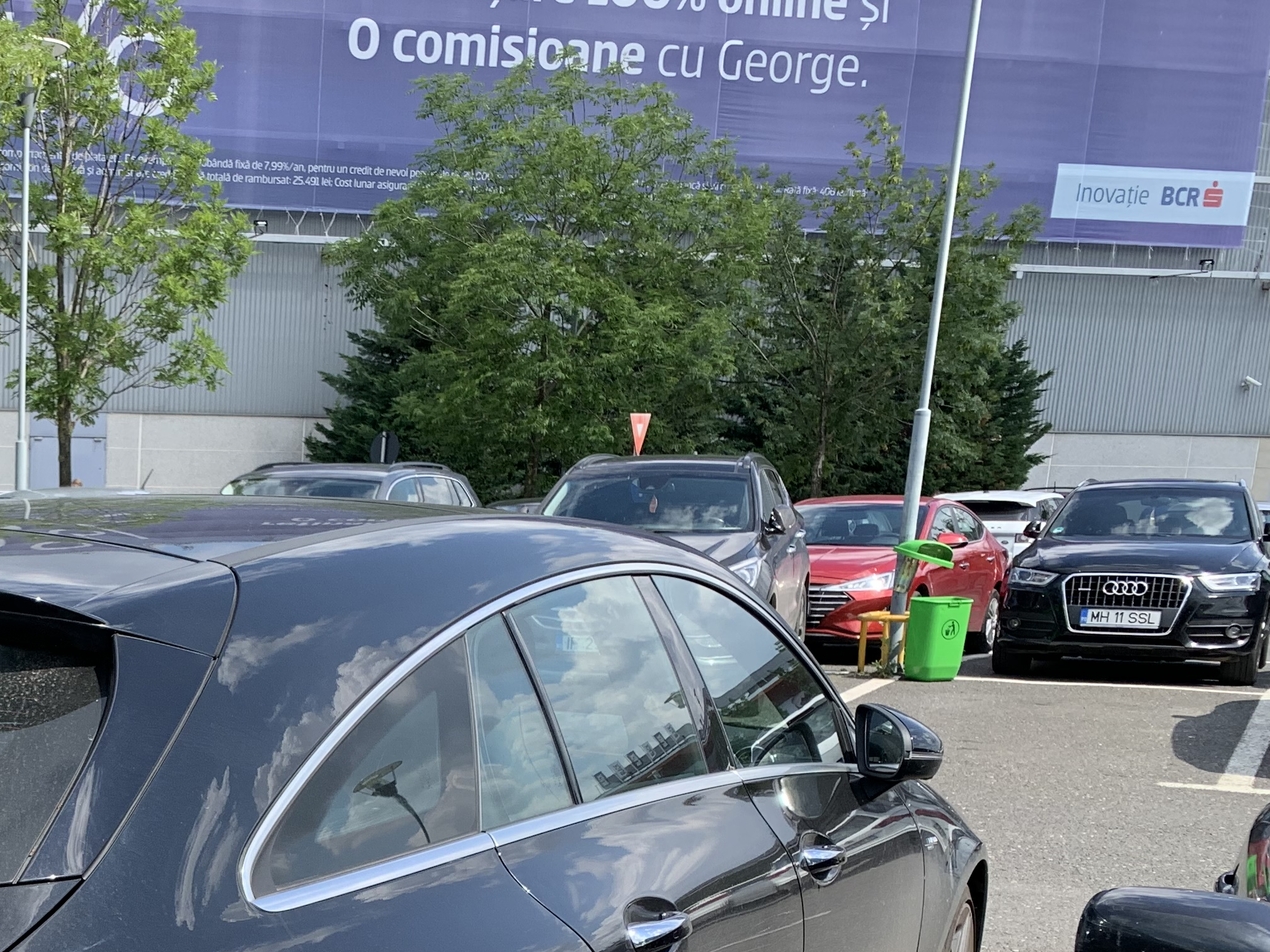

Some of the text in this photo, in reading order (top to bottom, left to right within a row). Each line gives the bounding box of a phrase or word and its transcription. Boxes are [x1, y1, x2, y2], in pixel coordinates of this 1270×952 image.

[392, 27, 646, 75] comisioane
[657, 43, 703, 78] cu
[718, 39, 869, 94] George.
[235, 159, 251, 170] fixă
[251, 161, 263, 171] de
[264, 161, 306, 174] 7,99%/an,
[307, 163, 336, 175] pentru
[336, 166, 347, 175] un
[348, 165, 373, 177] credit
[374, 167, 385, 177] de
[206, 172, 231, 182] totală
[232, 173, 243, 183] de
[244, 174, 292, 185] rambursat:
[292, 175, 320, 186] 25.491
[334, 177, 352, 188] Cost
[353, 179, 376, 189] lunar
[1076, 183, 1200, 208] Inovație BCR
[1090, 611, 1156, 625] MH 11 SSL
